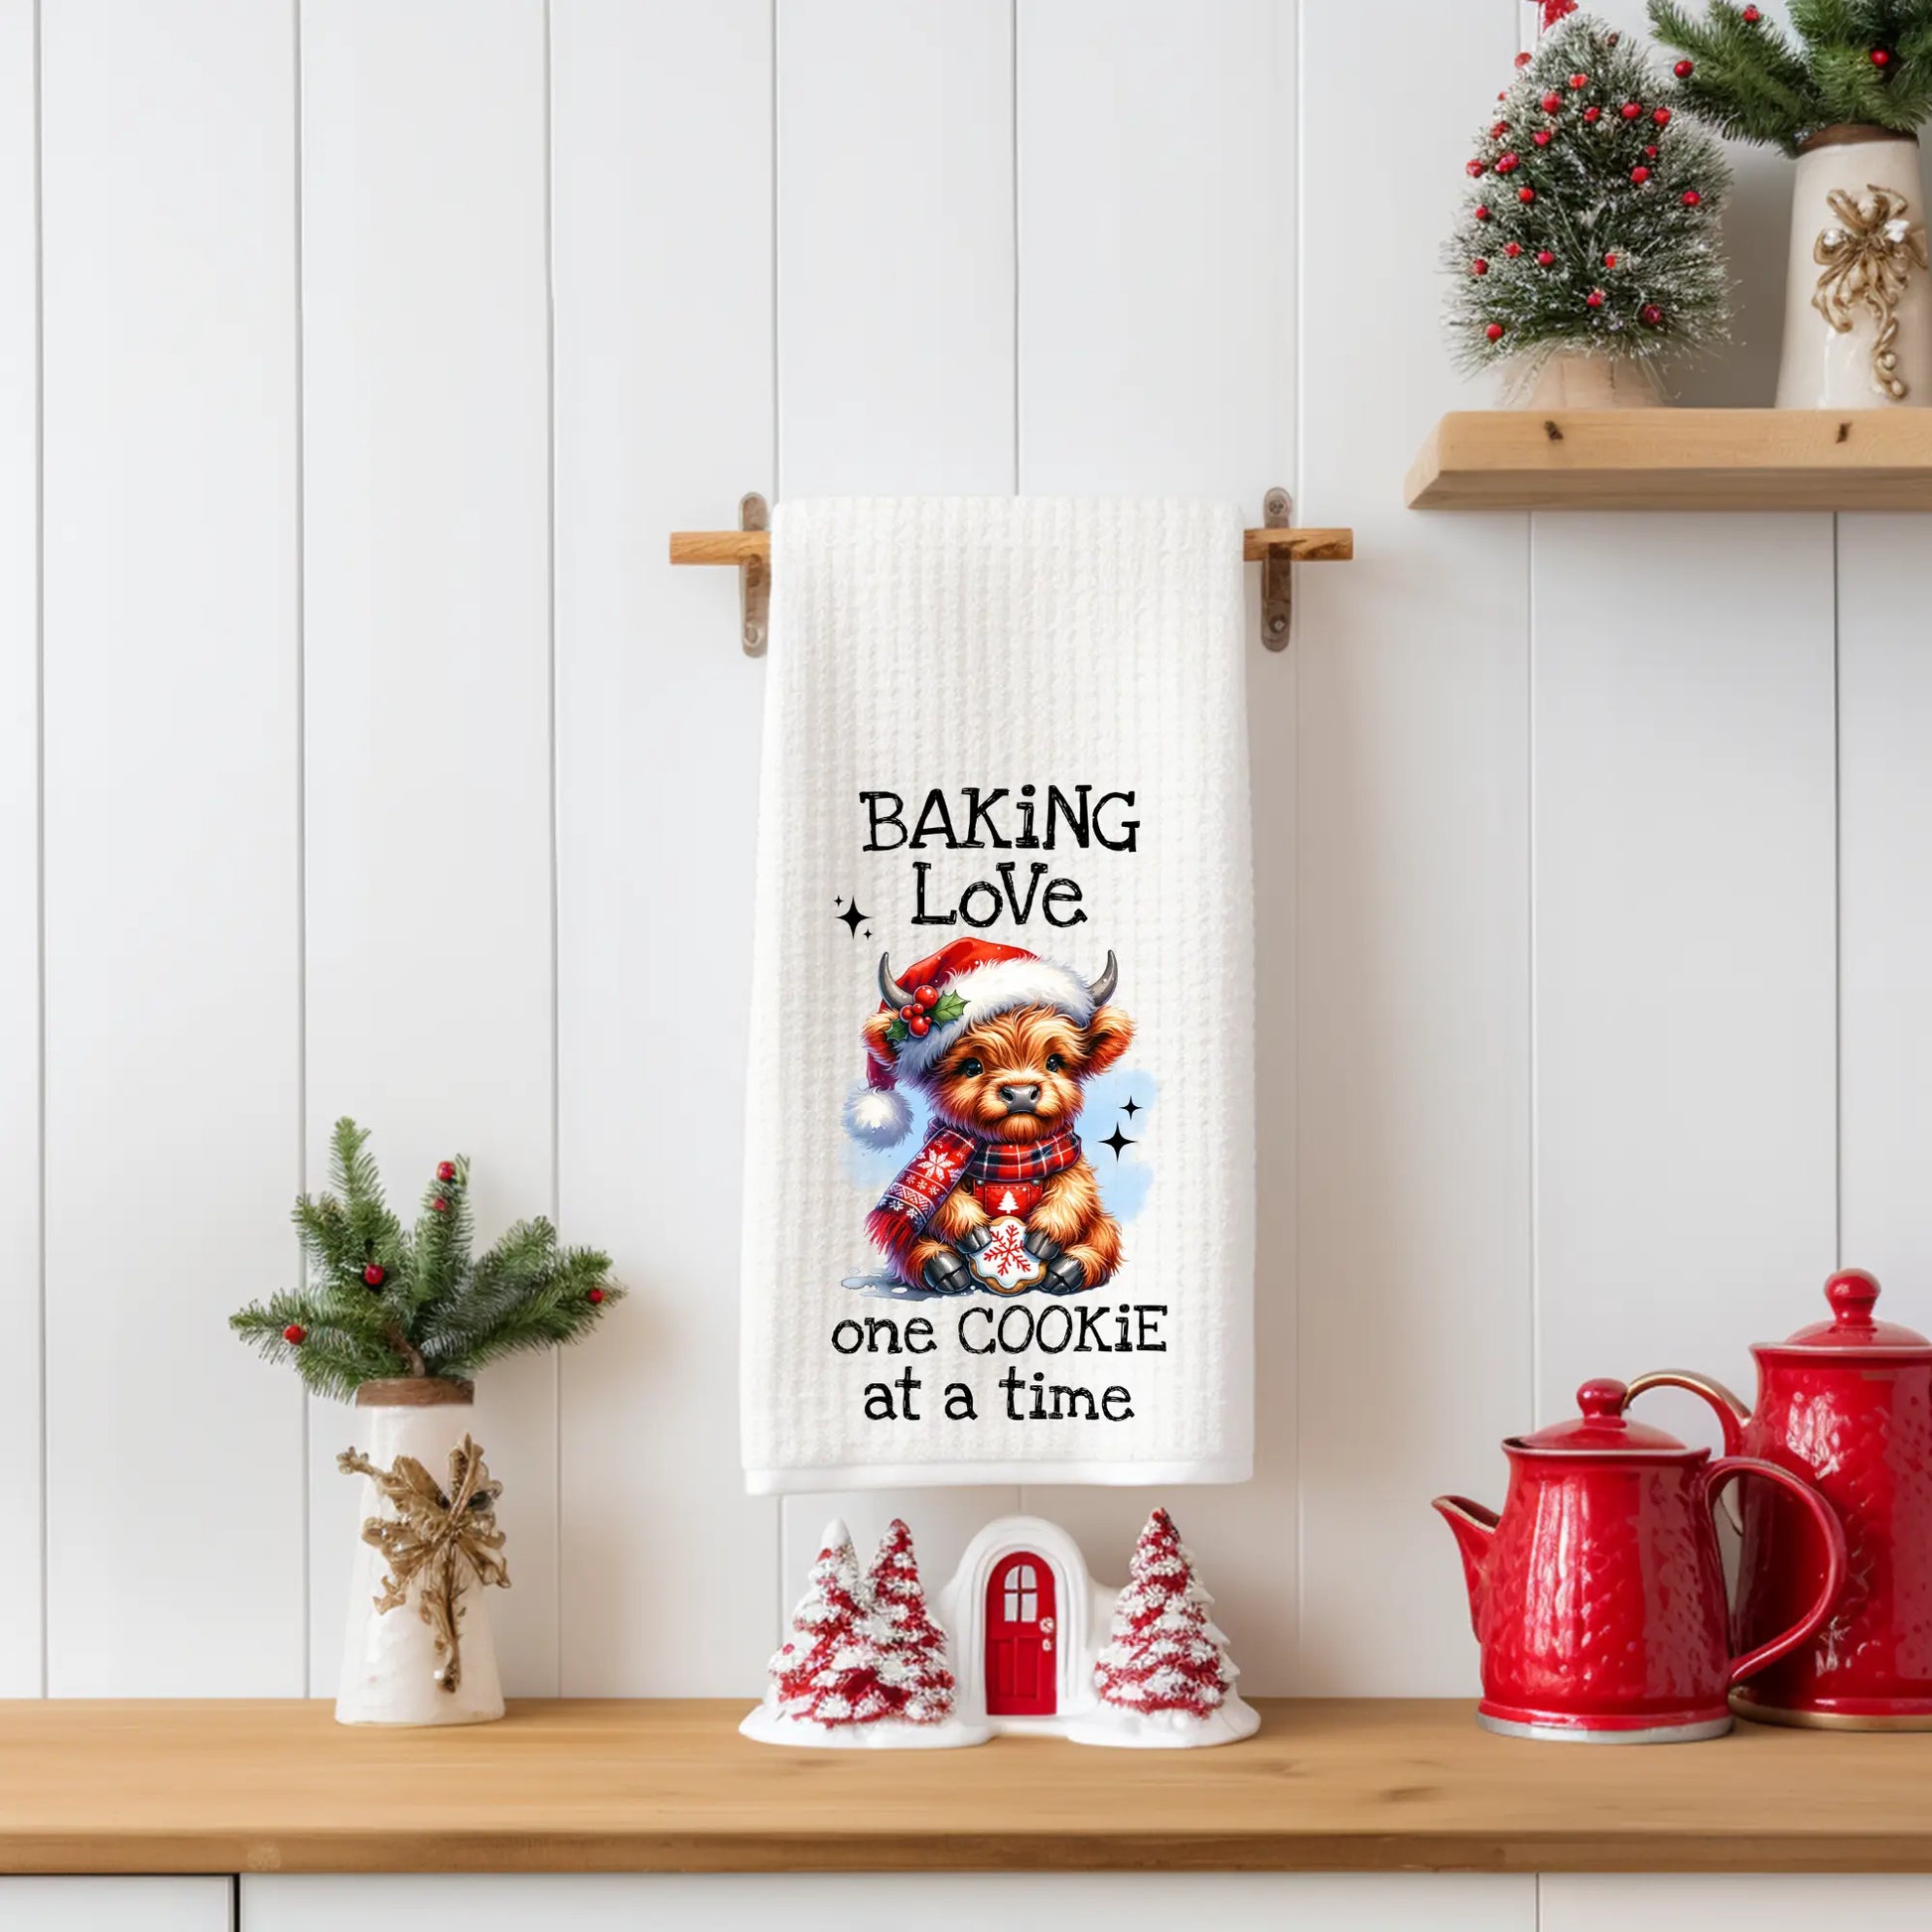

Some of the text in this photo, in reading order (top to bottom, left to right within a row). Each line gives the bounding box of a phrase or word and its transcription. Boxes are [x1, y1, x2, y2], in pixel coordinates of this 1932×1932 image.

[832, 1316, 937, 1354] one
[865, 1366, 1135, 1422] at a time
